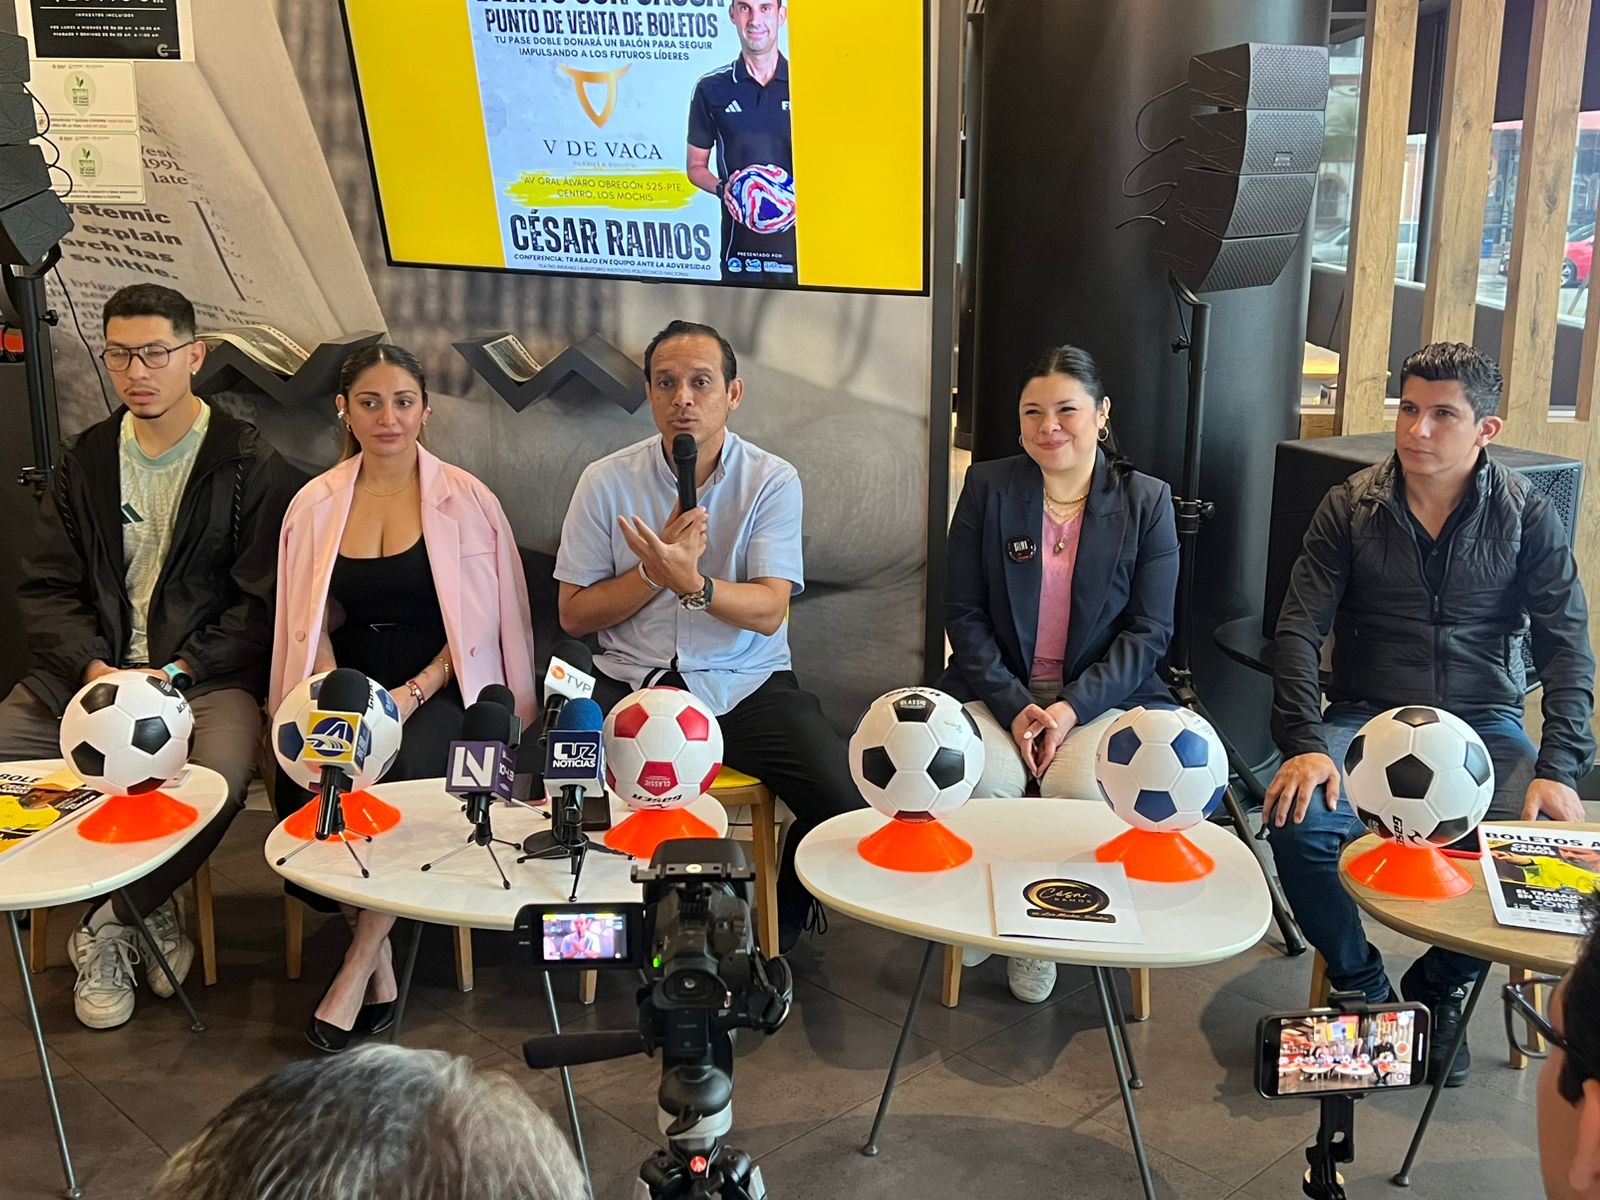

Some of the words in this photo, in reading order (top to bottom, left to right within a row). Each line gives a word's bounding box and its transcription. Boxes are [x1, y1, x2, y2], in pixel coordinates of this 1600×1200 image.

[485, 8, 540, 33] PUNTO
[543, 9, 564, 34] DE
[566, 10, 620, 35] VENTA
[622, 11, 644, 36] DE
[647, 11, 718, 38] BOLETOS
[495, 36, 506, 44] TU
[509, 36, 531, 44] PASE
[533, 37, 562, 45] DOBLE
[564, 36, 603, 46] DONARÁ
[604, 38, 617, 47] UN
[620, 37, 650, 48] BALÓN
[652, 40, 676, 48] PARA
[679, 40, 712, 49] SEGUIR
[519, 48, 578, 57] IMPULSANDO
[590, 50, 608, 58] LOS
[610, 50, 651, 59] FUTUROS
[654, 49, 689, 60] LÍDERES
[543, 139, 557, 154] V
[567, 140, 597, 157] DE
[604, 142, 663, 160] VACA
[150, 171, 189, 185] late
[524, 176, 535, 184] AV
[537, 177, 560, 186] GRAL
[563, 176, 596, 187] ÁLVARO
[598, 179, 643, 190] OBREGÓN
[598, 191, 615, 199] LOS
[617, 192, 653, 201] MOCHIS
[66, 203, 171, 224] ystemic
[82, 225, 183, 246] explain
[510, 208, 600, 255] CÉSAR
[605, 219, 711, 261] RAMOS
[123, 245, 175, 262] has
[104, 256, 179, 280] little.
[565, 256, 597, 264] TRABAJO
[665, 263, 711, 271] ADVERSIDAD
[567, 672, 591, 692] TVP
[553, 742, 597, 760] LUZ
[552, 759, 596, 768] NOTICIAS
[644, 779, 671, 788] CLASSIC
[1485, 832, 1583, 847] BOLETOS
[1530, 890, 1584, 900] TRABAJO
[1534, 895, 1579, 904] EQUIPO
